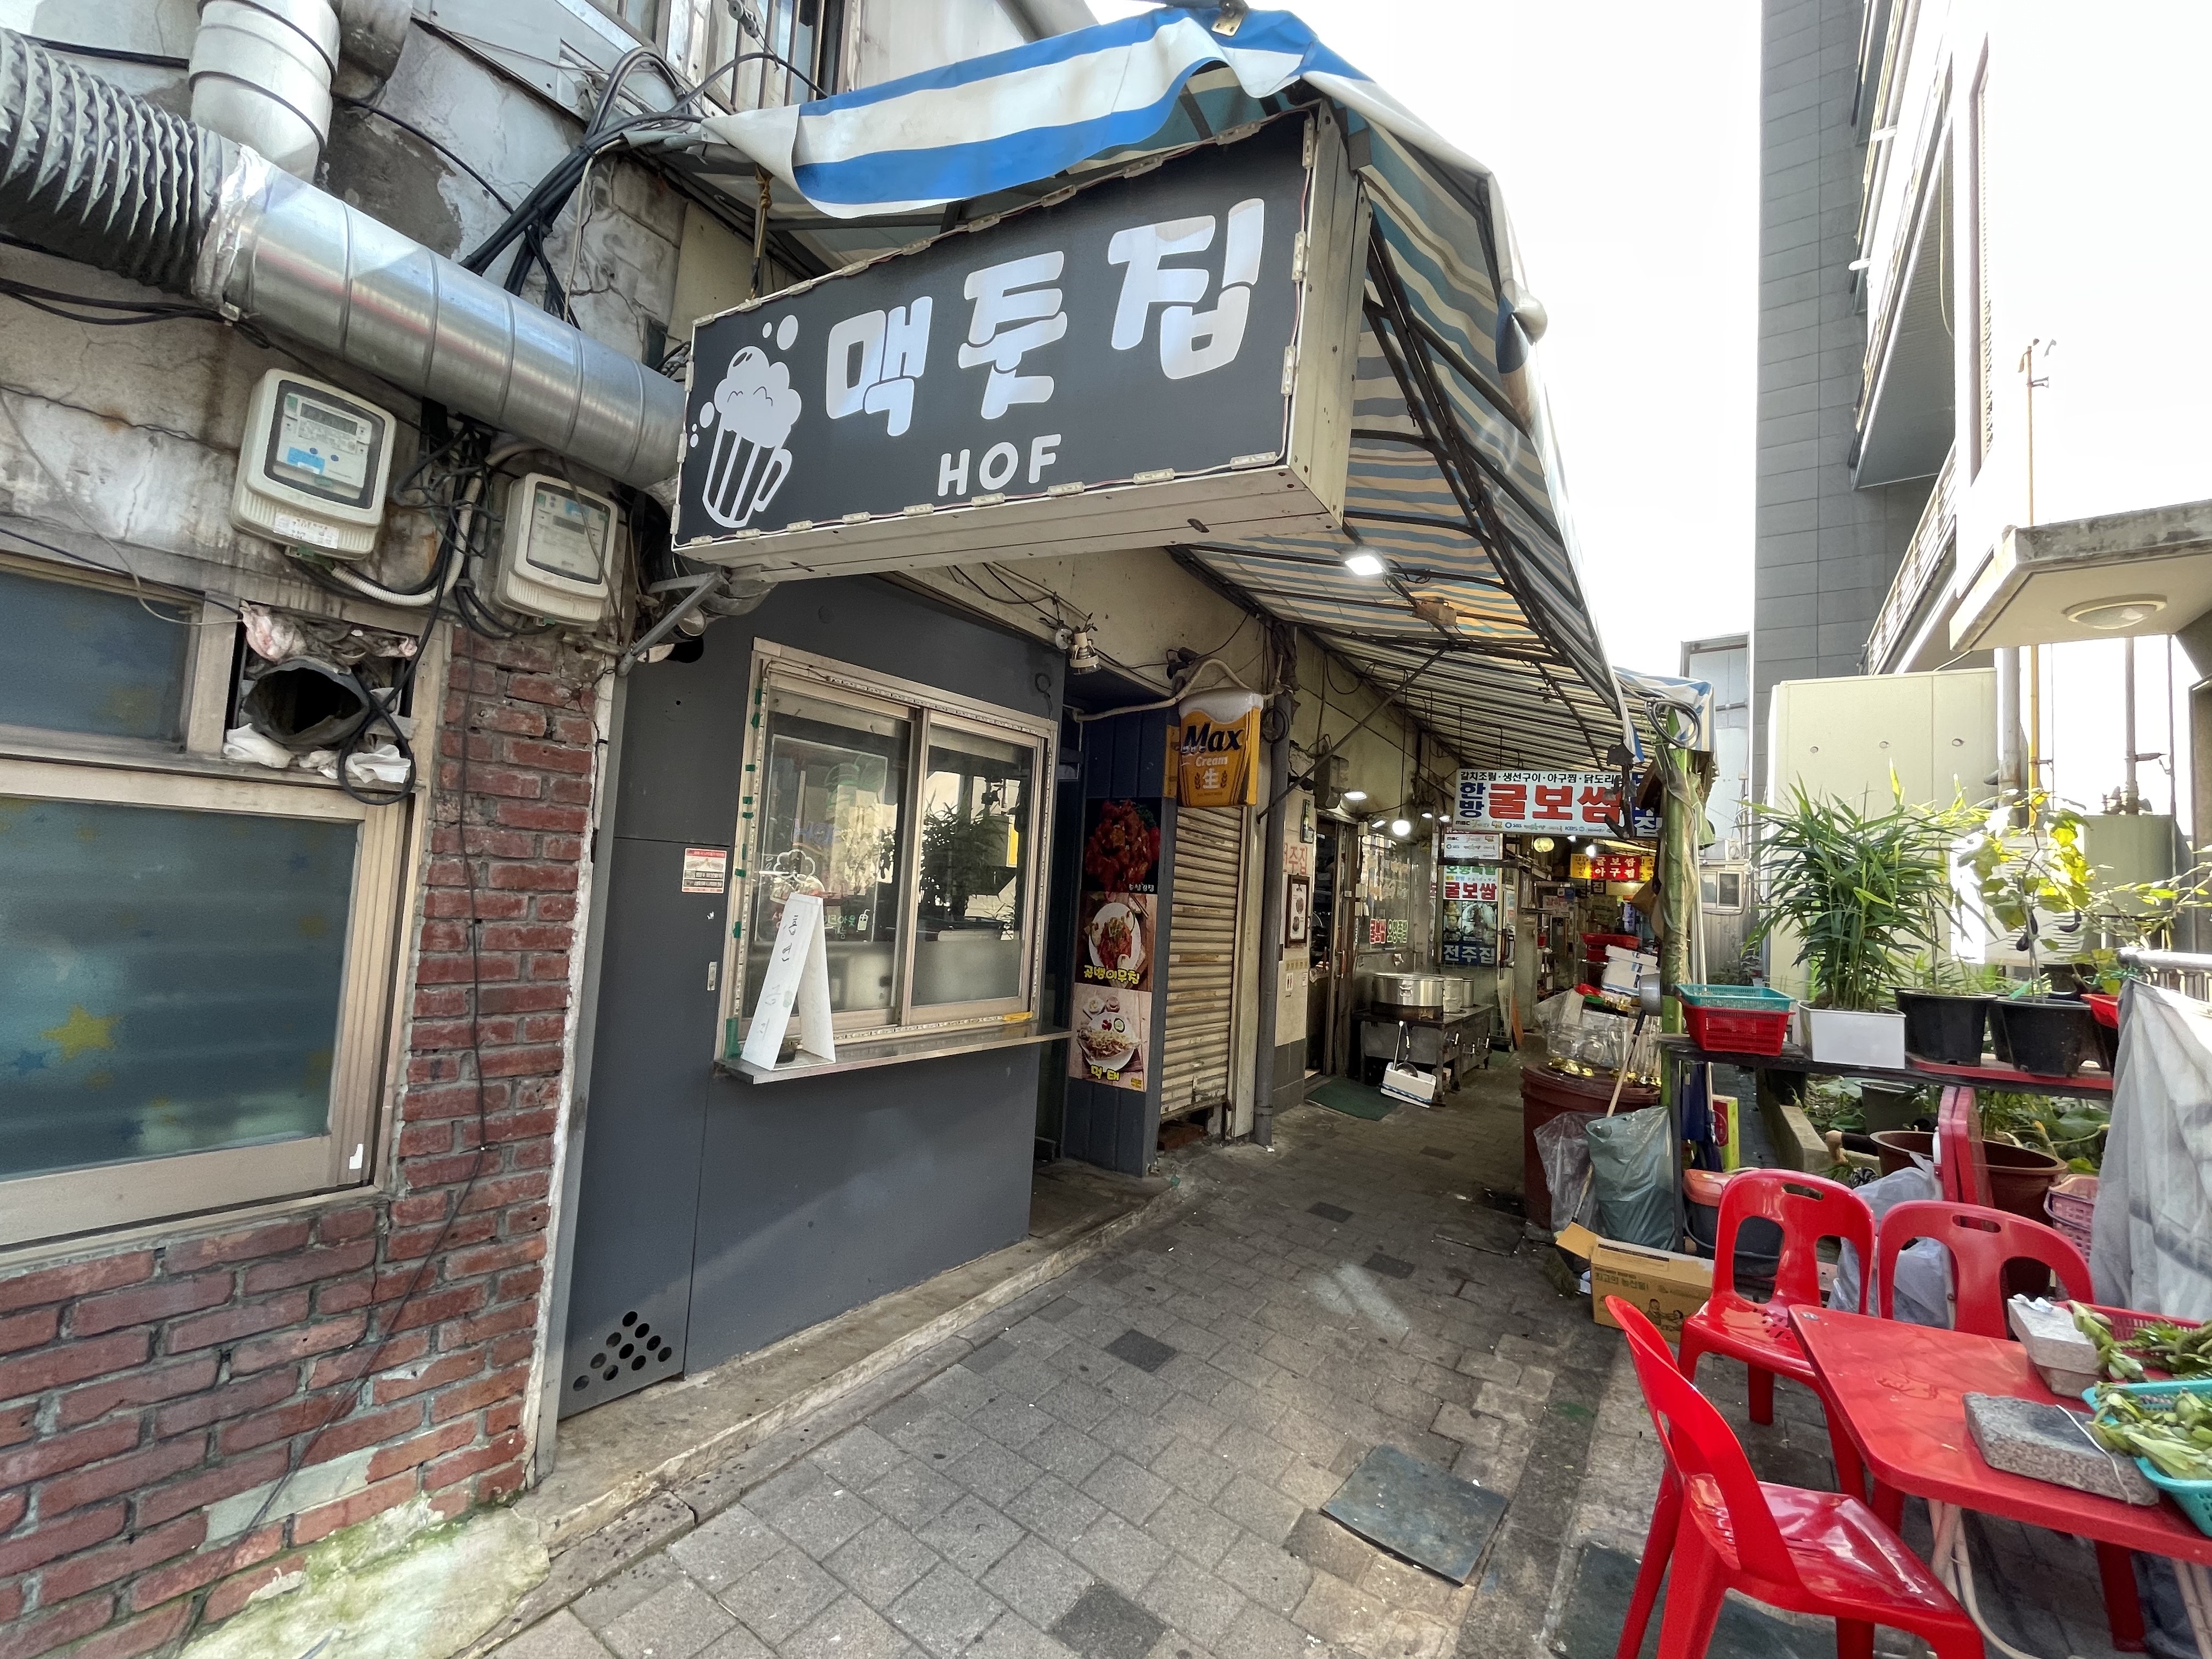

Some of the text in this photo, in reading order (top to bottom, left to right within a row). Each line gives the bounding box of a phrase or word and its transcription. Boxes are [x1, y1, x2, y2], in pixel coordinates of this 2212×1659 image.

[938, 435, 1060, 496] HOF
[1182, 721, 1244, 752] Max
[1195, 755, 1228, 767] Cream
[1203, 768, 1220, 789] 生
[1503, 772, 1541, 783] 생선구이
[1548, 773, 1577, 783] 아구찜
[1459, 781, 1486, 818] 한방
[1488, 783, 1622, 823] 굴보쌈
[1283, 843, 1308, 875] 주집
[1445, 881, 1497, 900] 굴보쌈
[1443, 945, 1495, 964] 전주집
[1084, 964, 1140, 984] 골뱅이무침
[1091, 1065, 1120, 1081] 먹태
